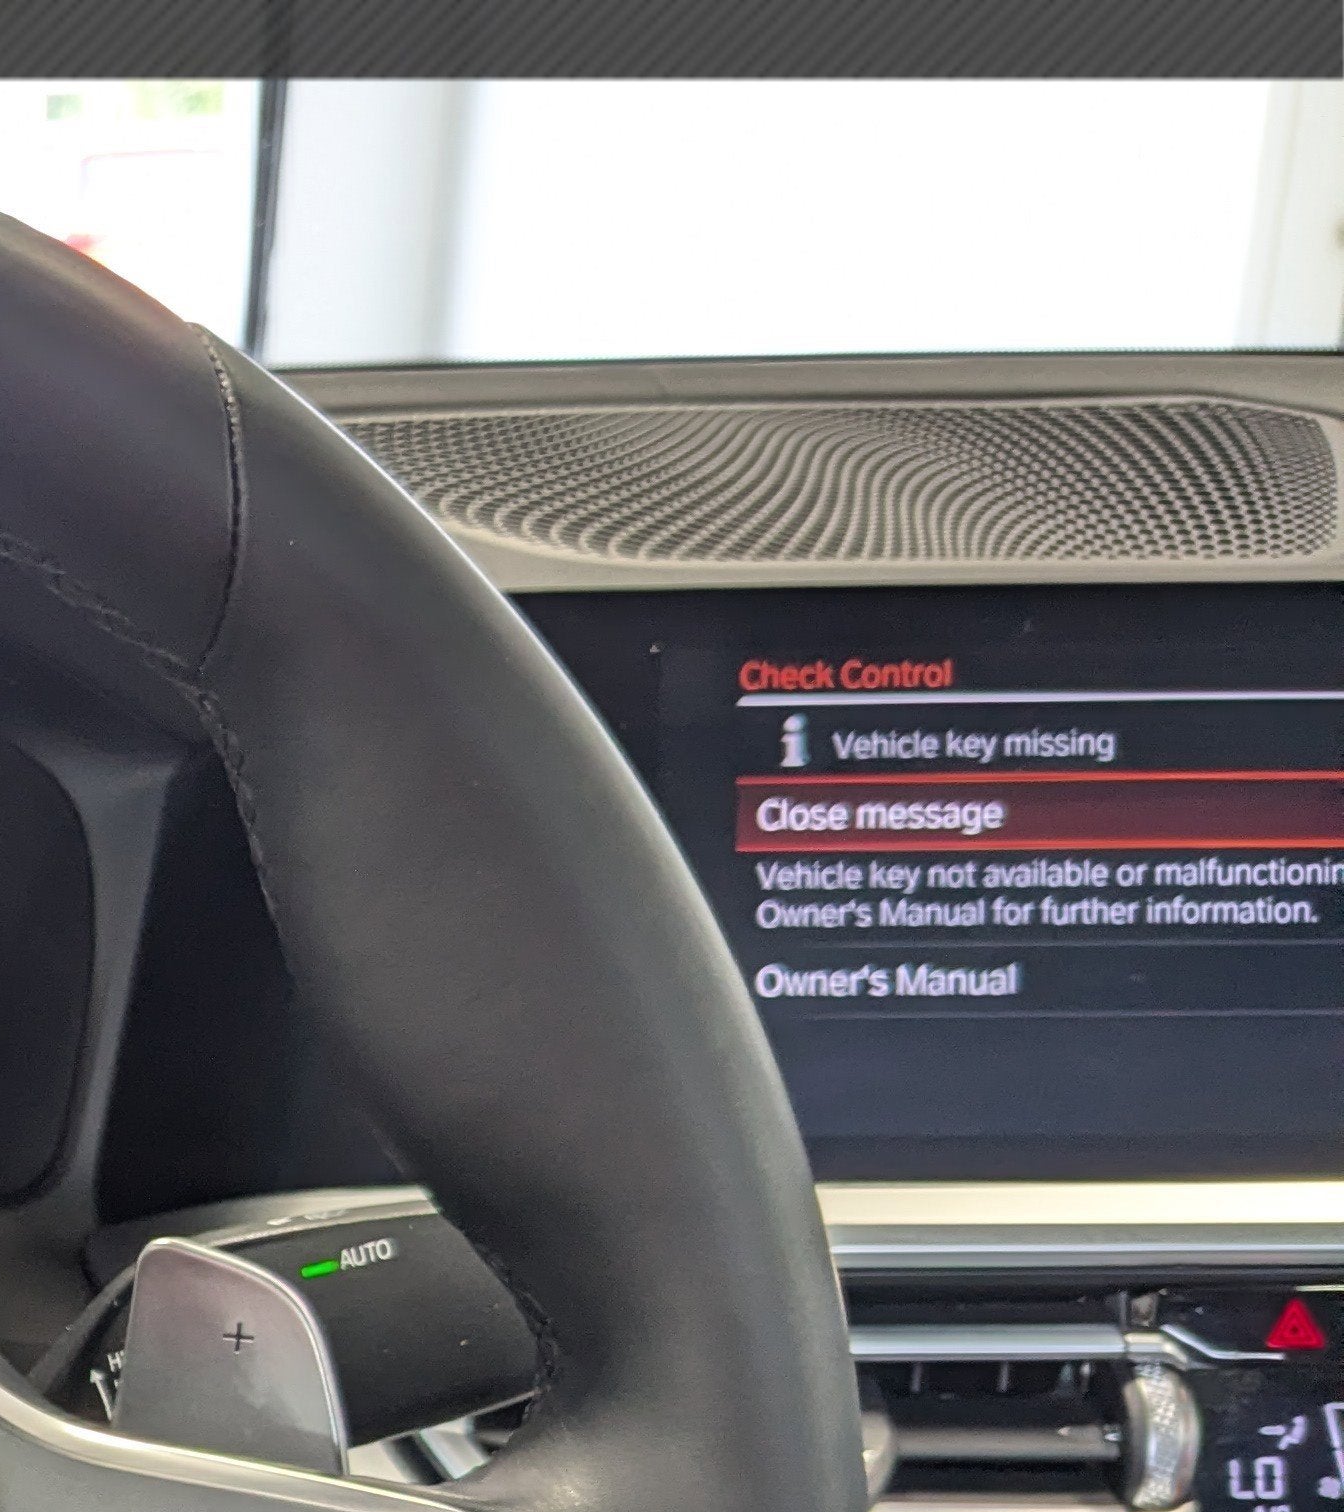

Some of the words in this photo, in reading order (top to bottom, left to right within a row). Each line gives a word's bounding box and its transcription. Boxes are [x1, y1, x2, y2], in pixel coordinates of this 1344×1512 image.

[739, 661, 831, 690] Check
[840, 659, 954, 689] Control
[832, 732, 938, 759] Vehicle
[946, 731, 995, 763] key
[1004, 730, 1116, 762] missing
[755, 800, 848, 831] Close
[856, 801, 1004, 834] message
[756, 863, 861, 891] Vehicle
[870, 861, 917, 895] key
[927, 862, 976, 887] not
[983, 859, 1109, 887] available
[1116, 864, 1146, 887] or
[1155, 857, 1344, 886] malfunctionin
[756, 898, 872, 928] Owner's
[880, 897, 985, 926] Manual
[993, 896, 1032, 925] for
[1041, 896, 1139, 925] further
[1147, 896, 1318, 924] information.
[755, 963, 888, 997] Owner's
[897, 963, 1020, 995] Manual
[340, 1240, 397, 1271] AUTO
[1229, 1456, 1285, 1500] LO
